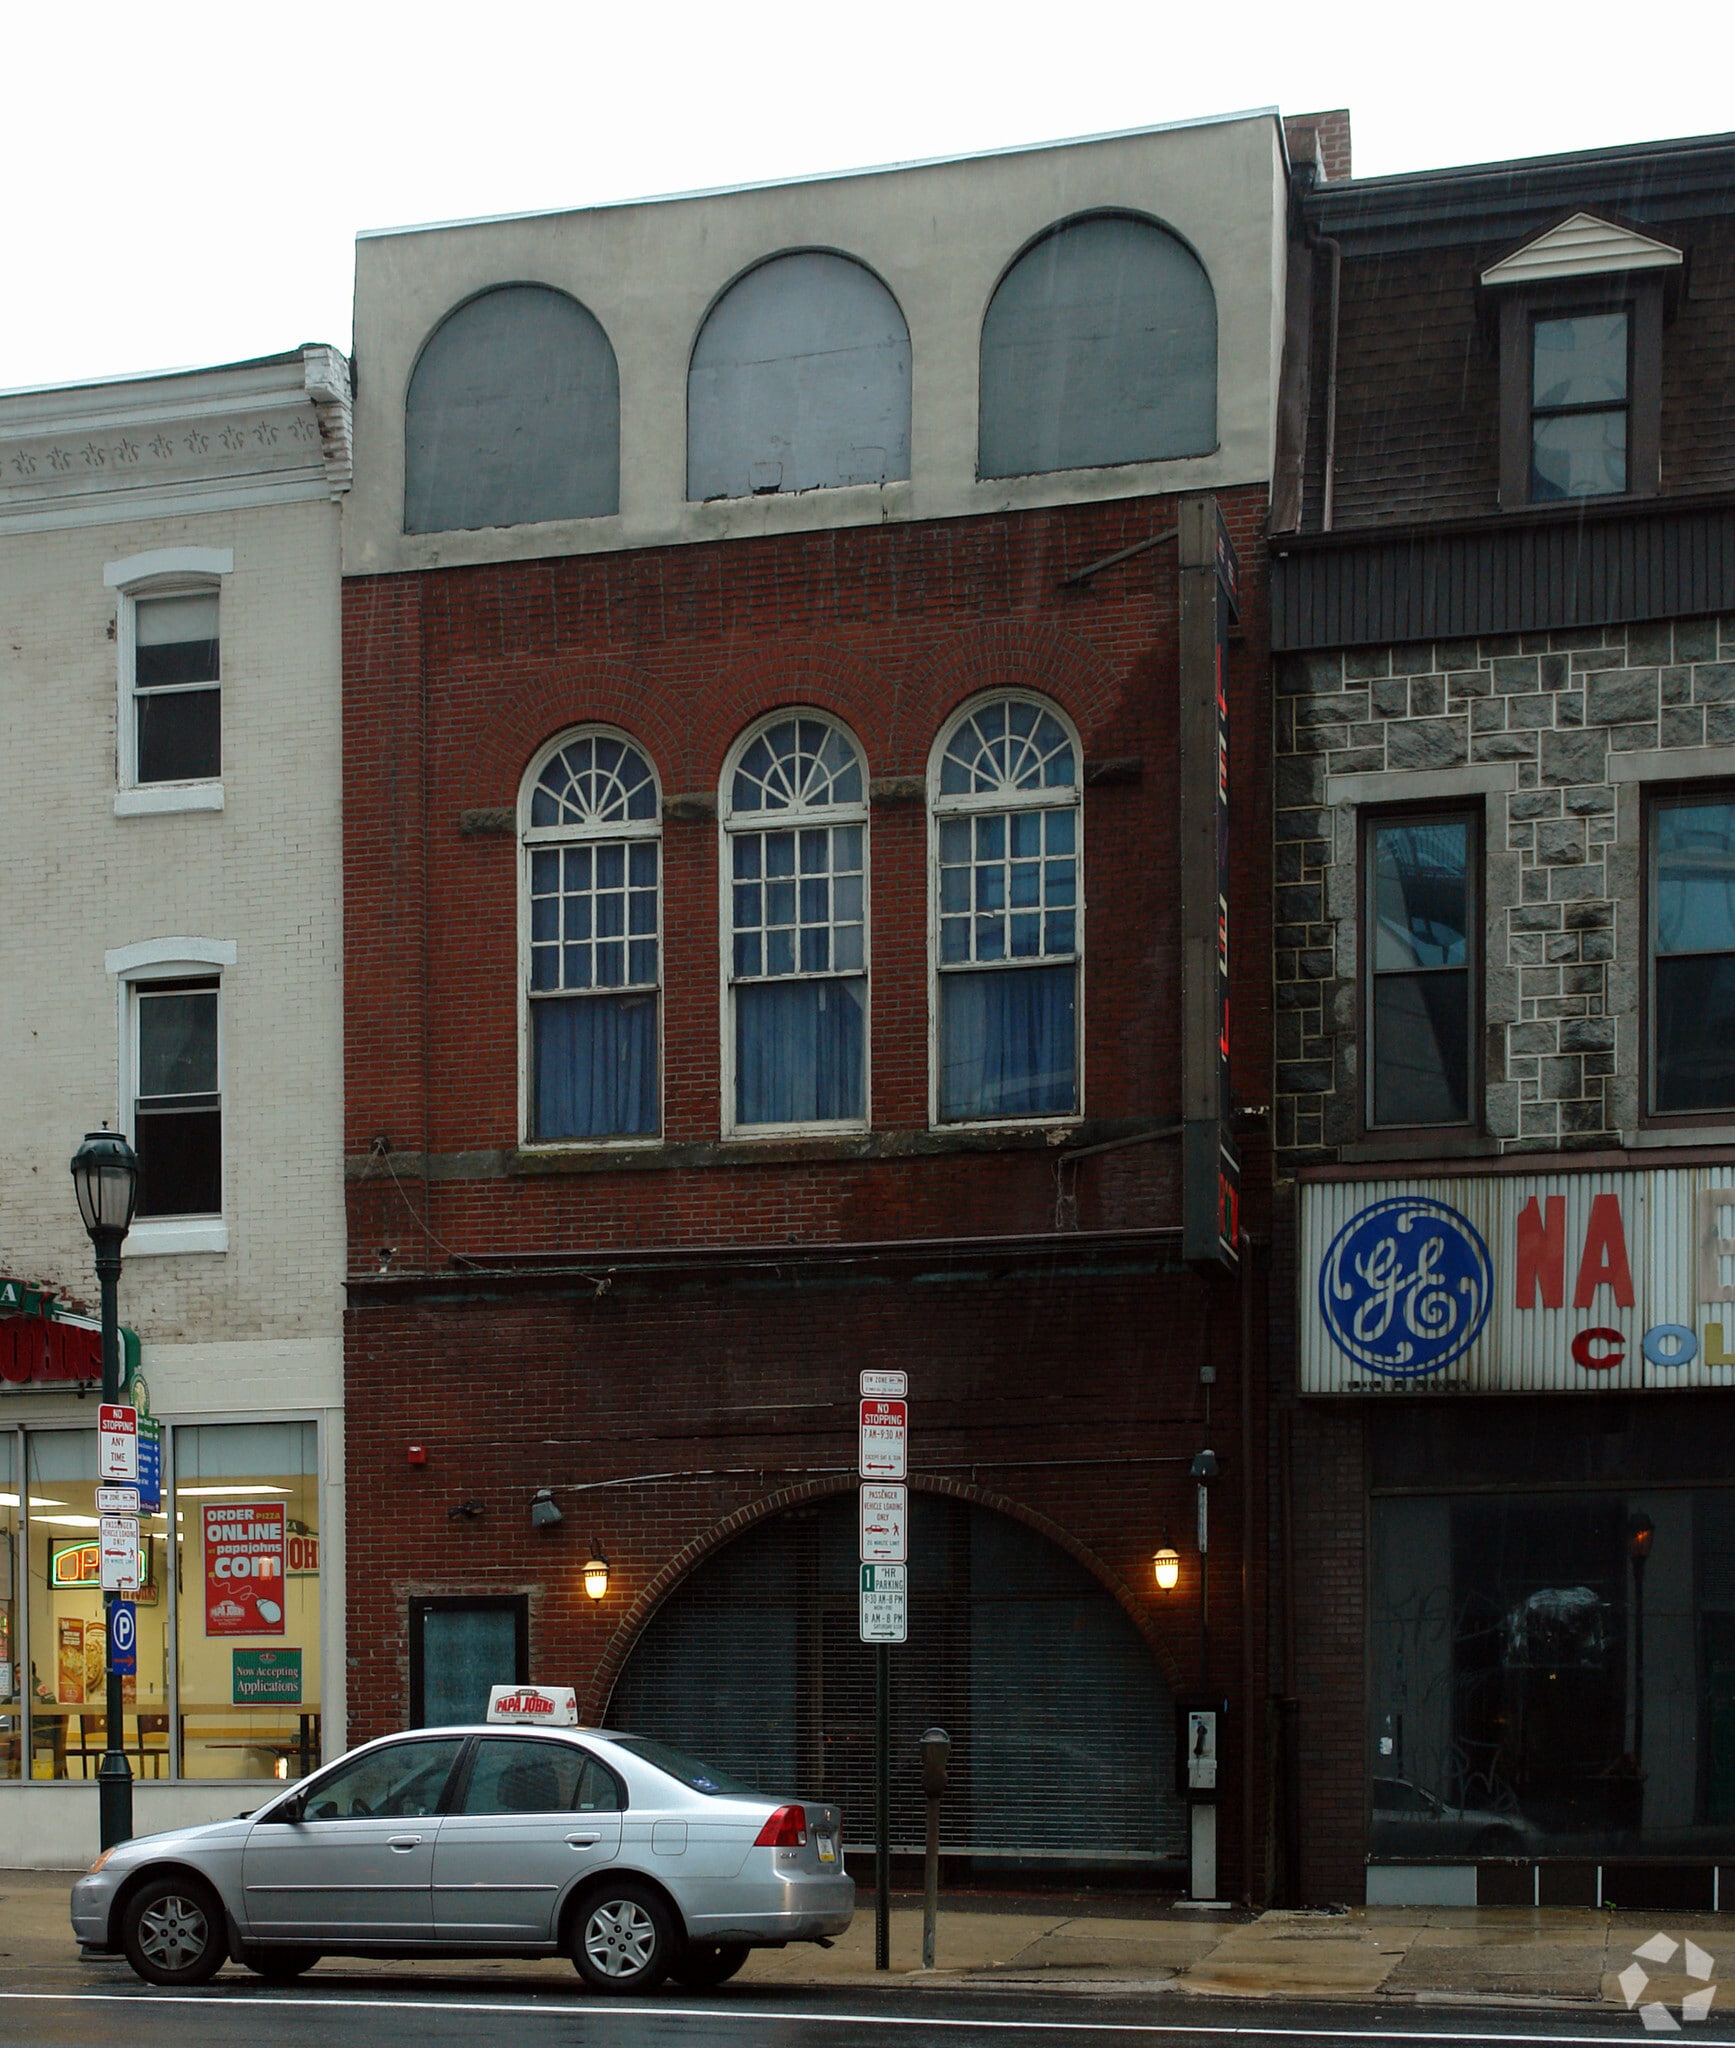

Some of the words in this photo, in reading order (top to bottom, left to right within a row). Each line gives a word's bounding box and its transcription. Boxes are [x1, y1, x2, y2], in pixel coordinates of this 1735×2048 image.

[1571, 1323, 1735, 1370] COL
[877, 1403, 889, 1414] NO
[113, 1409, 123, 1419] NO
[864, 1413, 902, 1425] STOPPING
[102, 1419, 134, 1432] STOPPING
[895, 1430, 903, 1440] AM
[111, 1437, 125, 1447] ANY
[111, 1452, 126, 1462] TIME
[869, 1491, 897, 1499] PASSENGER
[864, 1502, 882, 1510] VEHICLE
[883, 1503, 903, 1511] LOADING
[207, 1509, 254, 1521] ORDER
[256, 1512, 280, 1520] PIZZA
[877, 1513, 889, 1521] ONLY
[105, 1521, 132, 1530] PASSENGER
[207, 1523, 281, 1542] ONLINE
[113, 1538, 126, 1546] ONLY
[217, 1542, 282, 1555] papajohns
[884, 1568, 896, 1577] HR
[876, 1579, 903, 1590] PARKING
[894, 1595, 903, 1604] PM
[871, 1613, 881, 1623] AM
[893, 1613, 903, 1623] PM
[119, 1616, 130, 1643] P
[236, 1666, 254, 1676] Now
[257, 1666, 298, 1678] Accepting
[237, 1679, 298, 1695] Applications
[496, 1696, 521, 1712] PAPA
[522, 1696, 554, 1713] JOHNS
